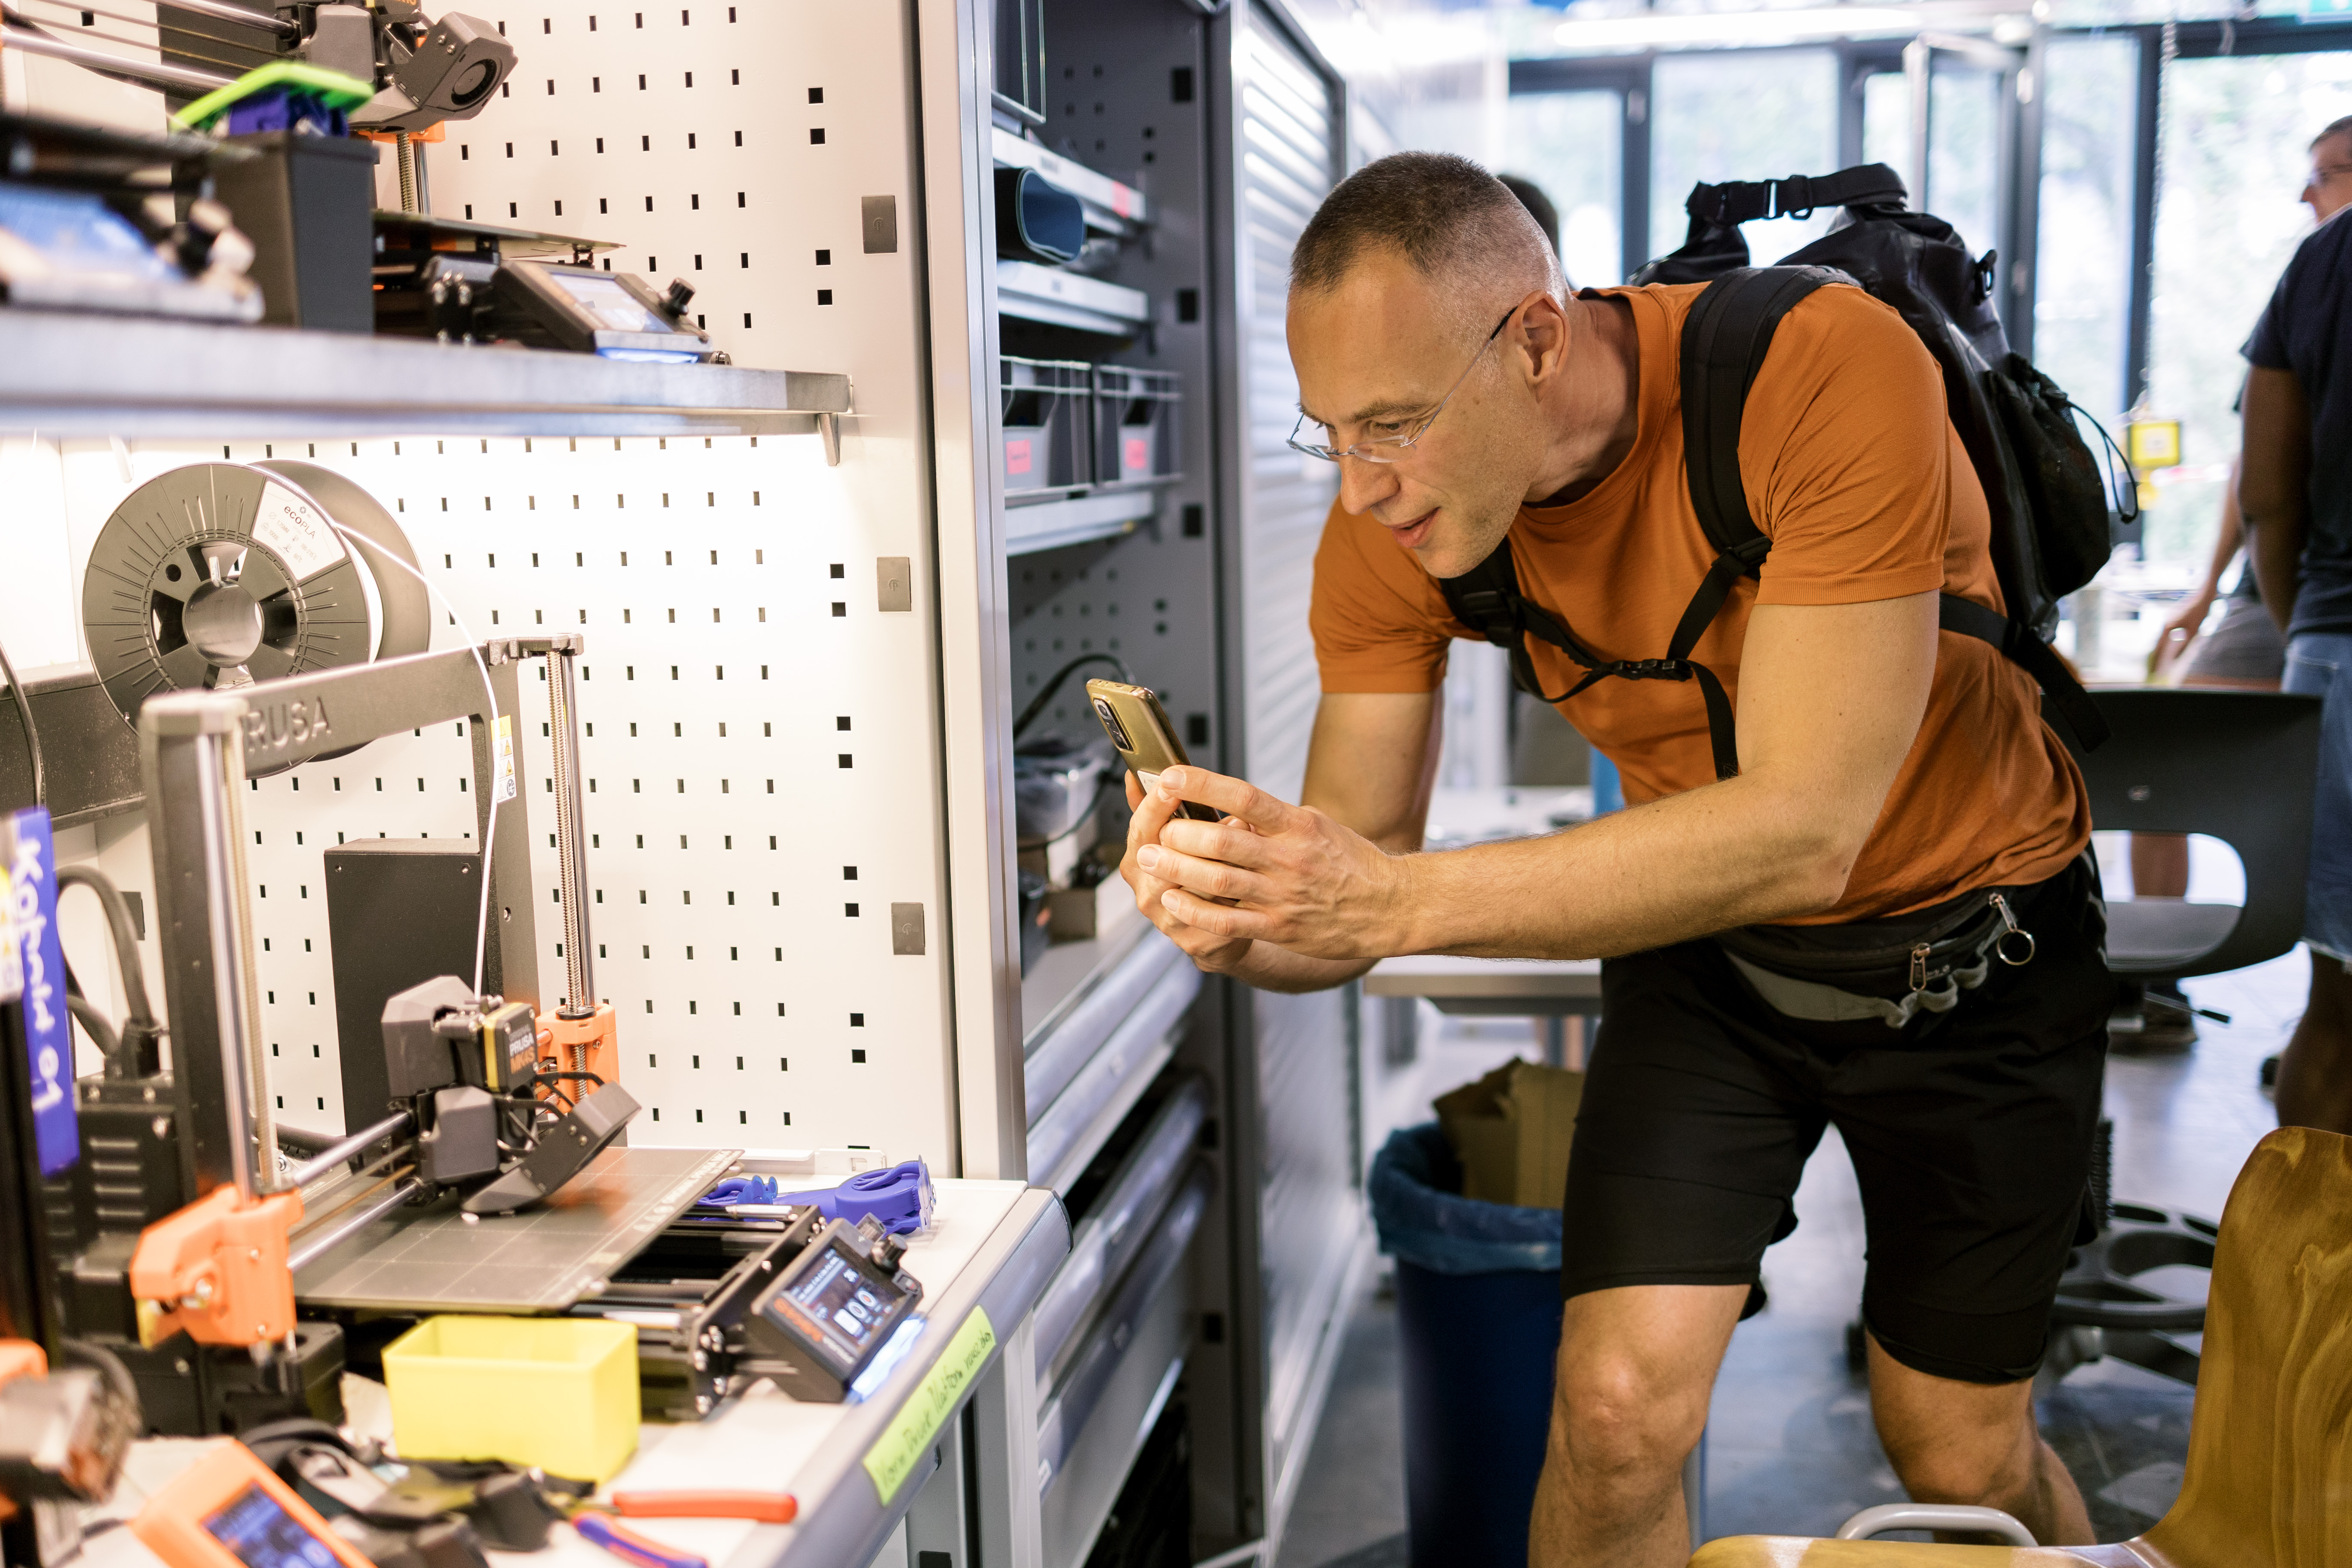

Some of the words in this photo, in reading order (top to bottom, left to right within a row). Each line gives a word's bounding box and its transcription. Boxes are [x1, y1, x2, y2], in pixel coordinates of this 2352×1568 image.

[284, 506, 315, 539] ecoPLA
[240, 696, 332, 754] RUSA
[509, 1032, 535, 1057] PRUSA
